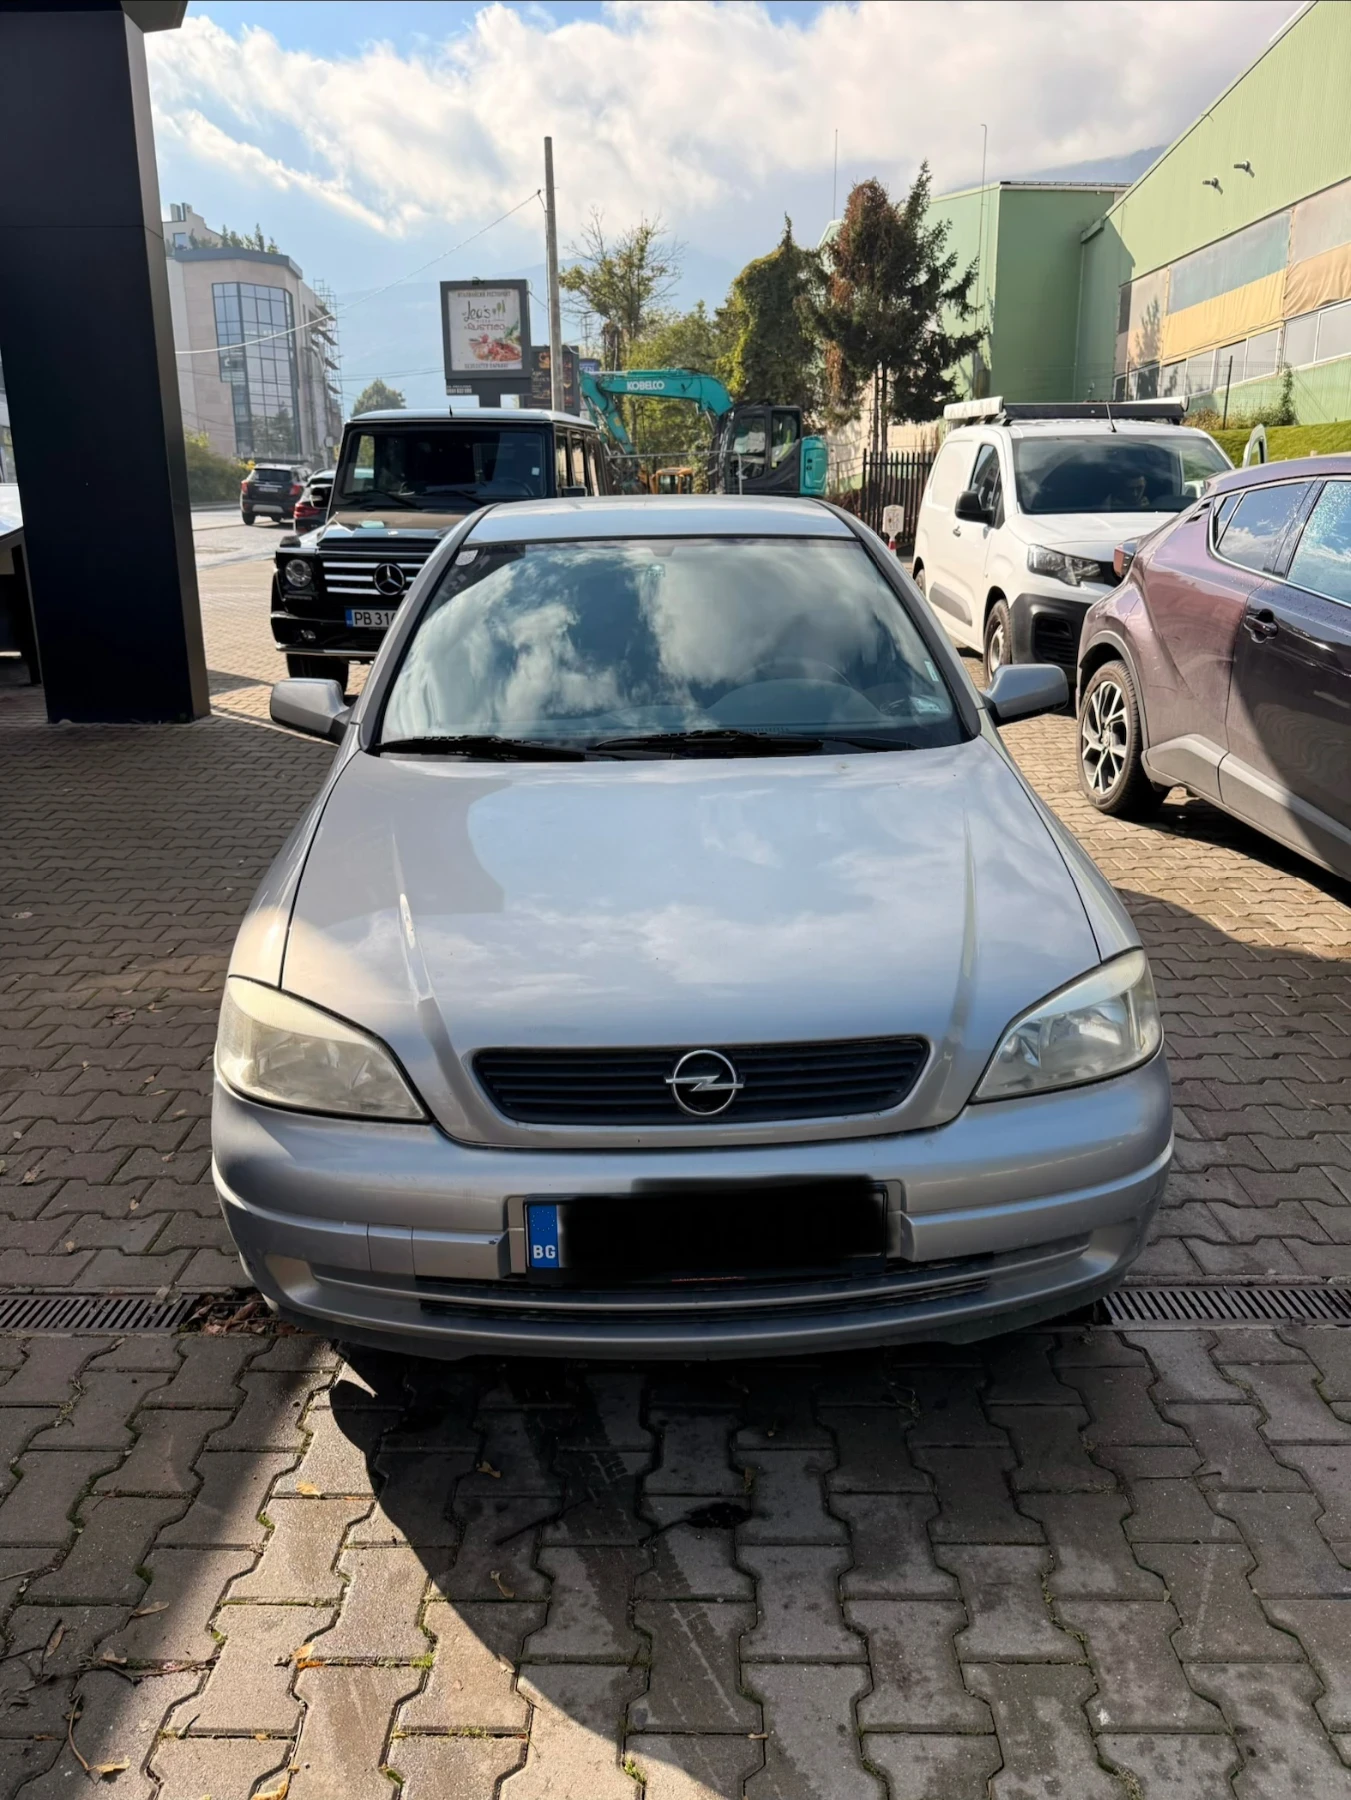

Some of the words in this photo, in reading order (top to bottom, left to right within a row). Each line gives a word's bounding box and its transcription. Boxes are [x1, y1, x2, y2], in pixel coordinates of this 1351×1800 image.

[627, 380, 665, 390] KOBELCO
[354, 611, 372, 626] PB
[533, 1244, 556, 1259] BG
